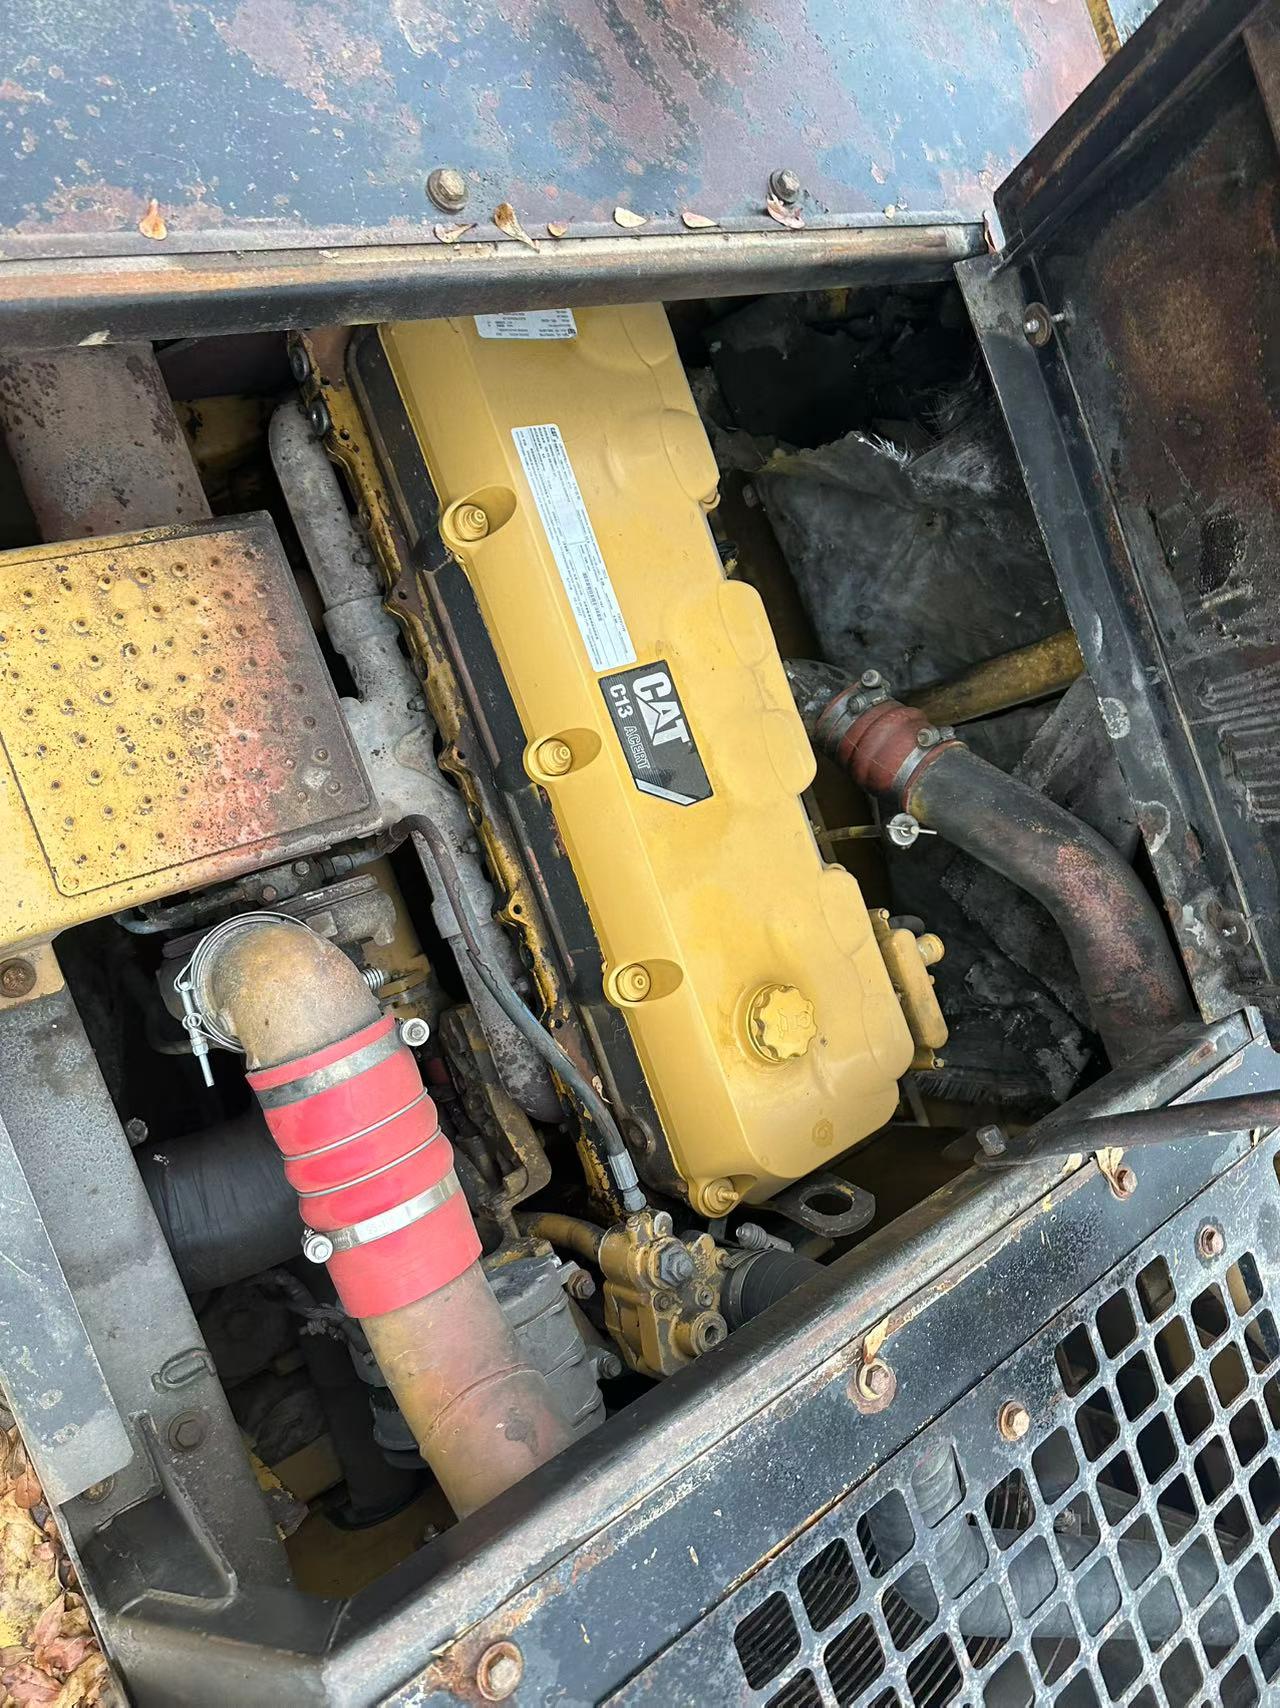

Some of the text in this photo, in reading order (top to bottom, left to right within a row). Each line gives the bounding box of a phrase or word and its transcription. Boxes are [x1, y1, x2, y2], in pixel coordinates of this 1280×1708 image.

[609, 683, 650, 769] C13 ACERT
[632, 671, 691, 746] CAT
